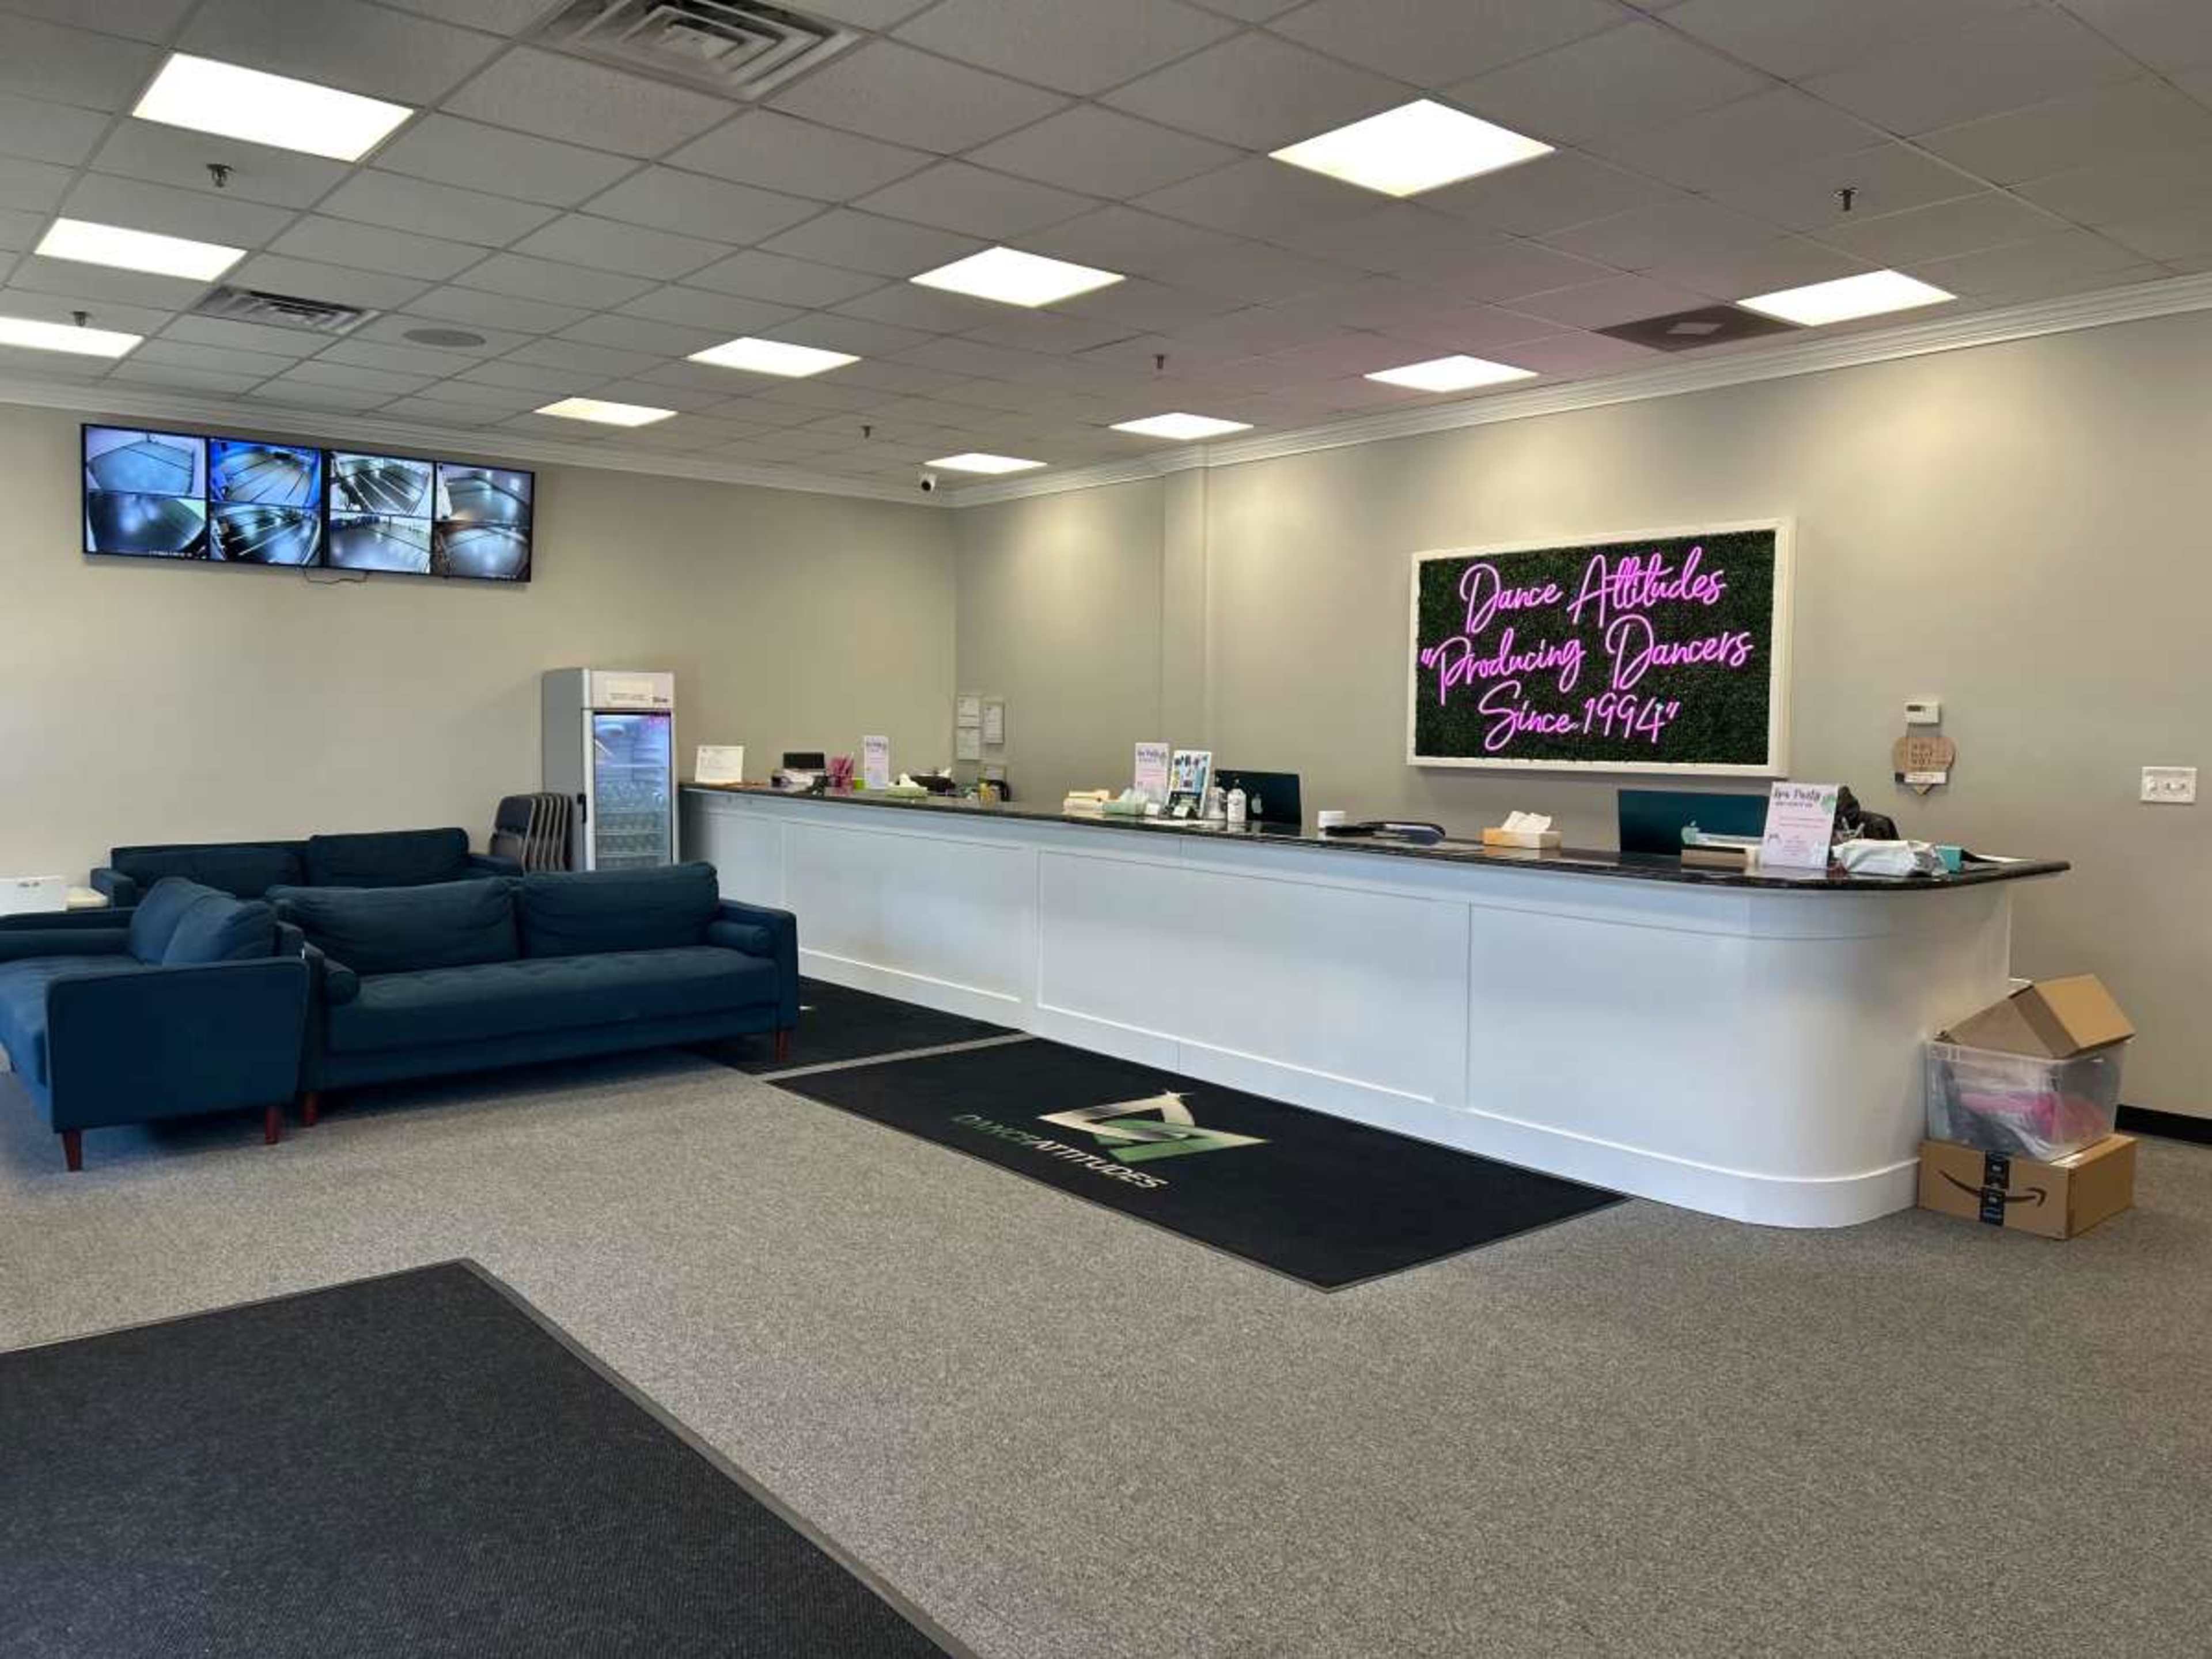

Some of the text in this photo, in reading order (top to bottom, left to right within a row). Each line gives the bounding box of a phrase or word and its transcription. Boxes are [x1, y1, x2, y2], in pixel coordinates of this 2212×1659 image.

[1460, 547, 1727, 634] Dance Attitudes
[1422, 614, 1753, 705] "Producing Dancers
[1478, 680, 1680, 750] Since 1994"
